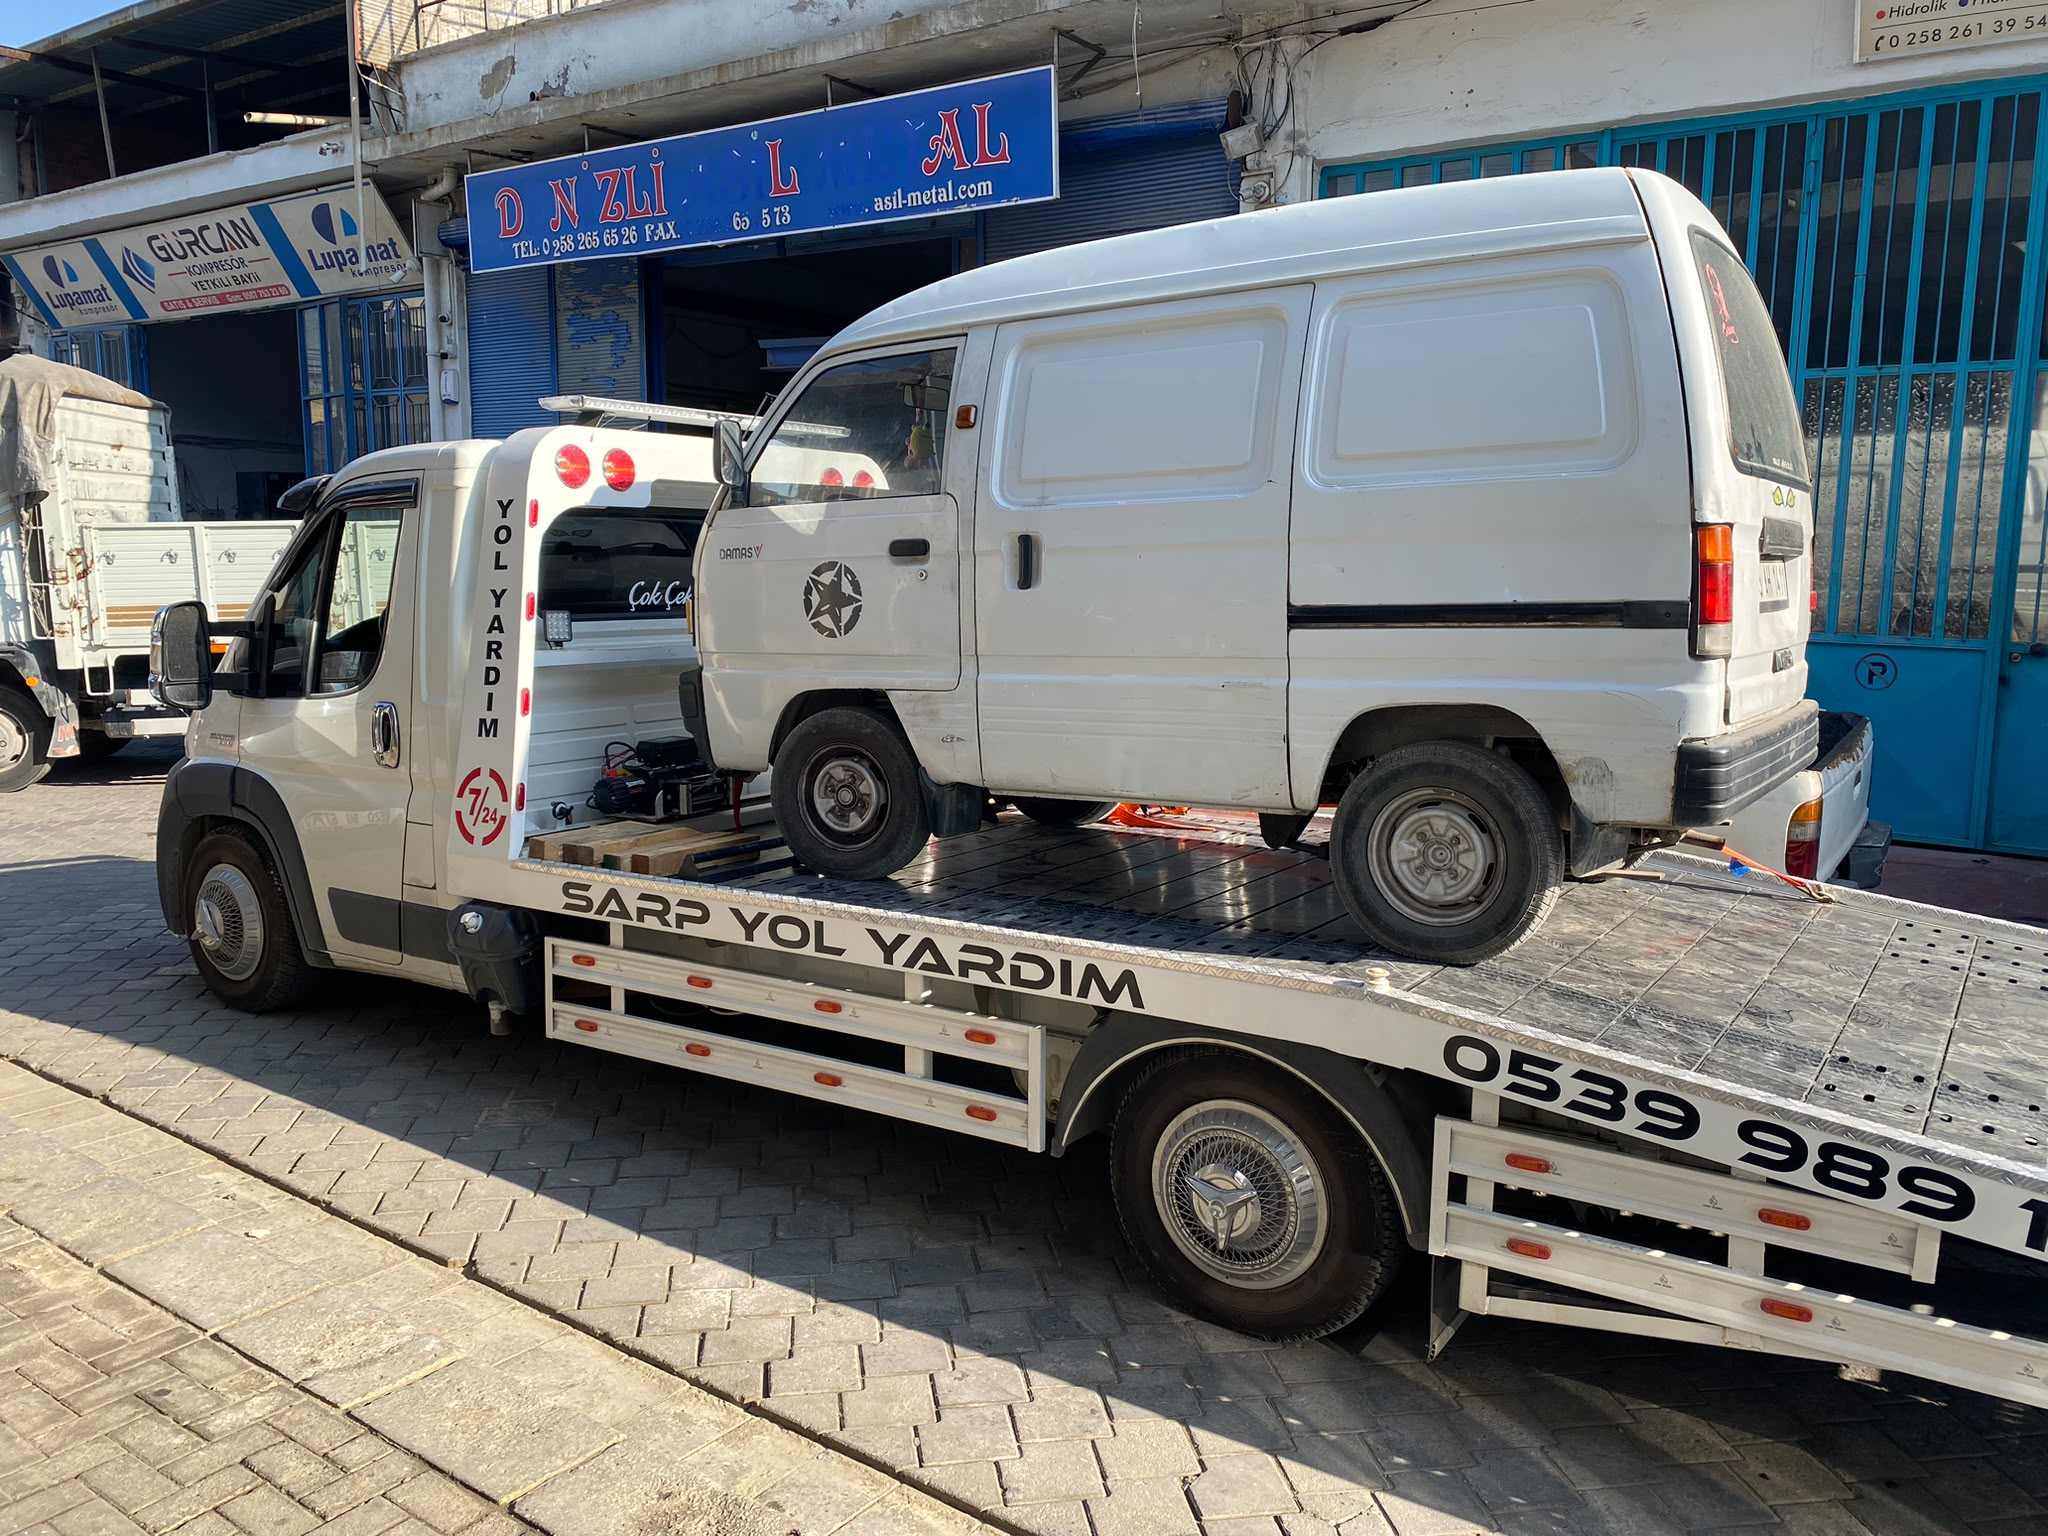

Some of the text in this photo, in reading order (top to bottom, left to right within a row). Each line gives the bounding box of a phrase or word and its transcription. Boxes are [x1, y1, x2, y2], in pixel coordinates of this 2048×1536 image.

[1889, 0, 1947, 18] Hidrolik
[1889, 14, 2048, 48] 0 258 261 39 54
[146, 217, 261, 262] GÜRCAN
[512, 239, 541, 259] TEL:
[542, 238, 550, 255] 0
[552, 234, 575, 257] 258
[578, 231, 600, 251] 265
[603, 228, 619, 247] 65
[622, 225, 638, 245] 26
[644, 221, 682, 242] FAX.
[185, 255, 249, 277] KOMPRESÖR
[45, 283, 112, 311] Lupamat
[191, 276, 233, 292] YETKİLİ
[77, 303, 118, 316] kompresör
[628, 581, 663, 612] Çok
[477, 498, 514, 738] YOL YARDIM
[468, 786, 498, 827] 7/24
[561, 880, 1147, 1010] SARP YOL YARDIM
[1442, 1033, 1702, 1142] 0539
[1735, 1118, 1977, 1223] 989
